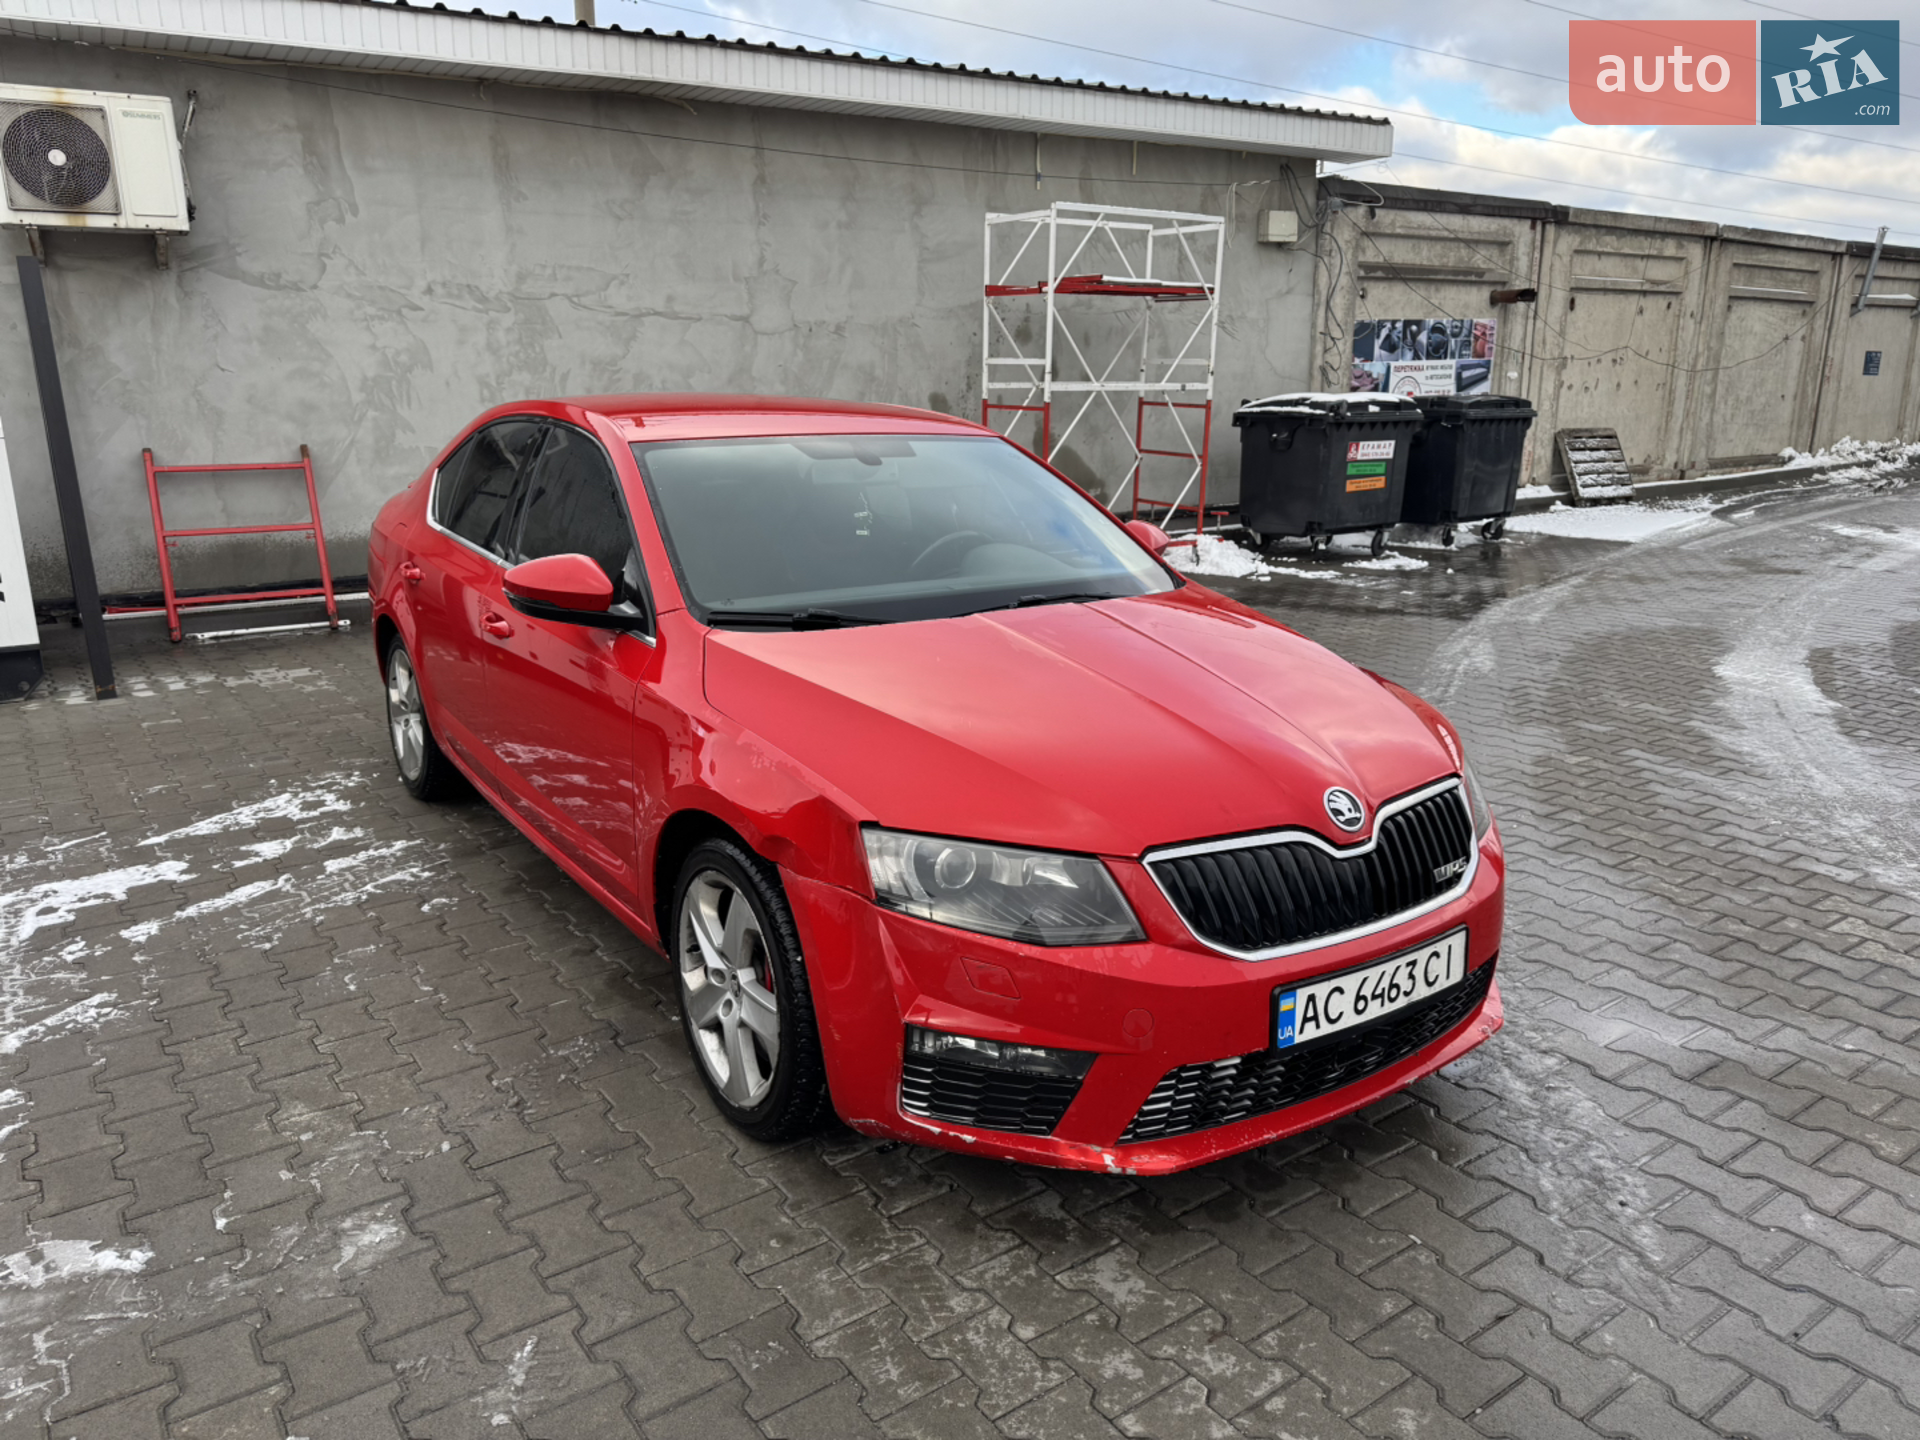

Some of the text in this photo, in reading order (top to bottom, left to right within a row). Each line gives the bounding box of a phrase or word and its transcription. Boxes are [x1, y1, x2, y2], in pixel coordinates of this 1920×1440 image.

[1298, 944, 1452, 1036] AC 6463 CI
[1278, 1025, 1294, 1040] UA
